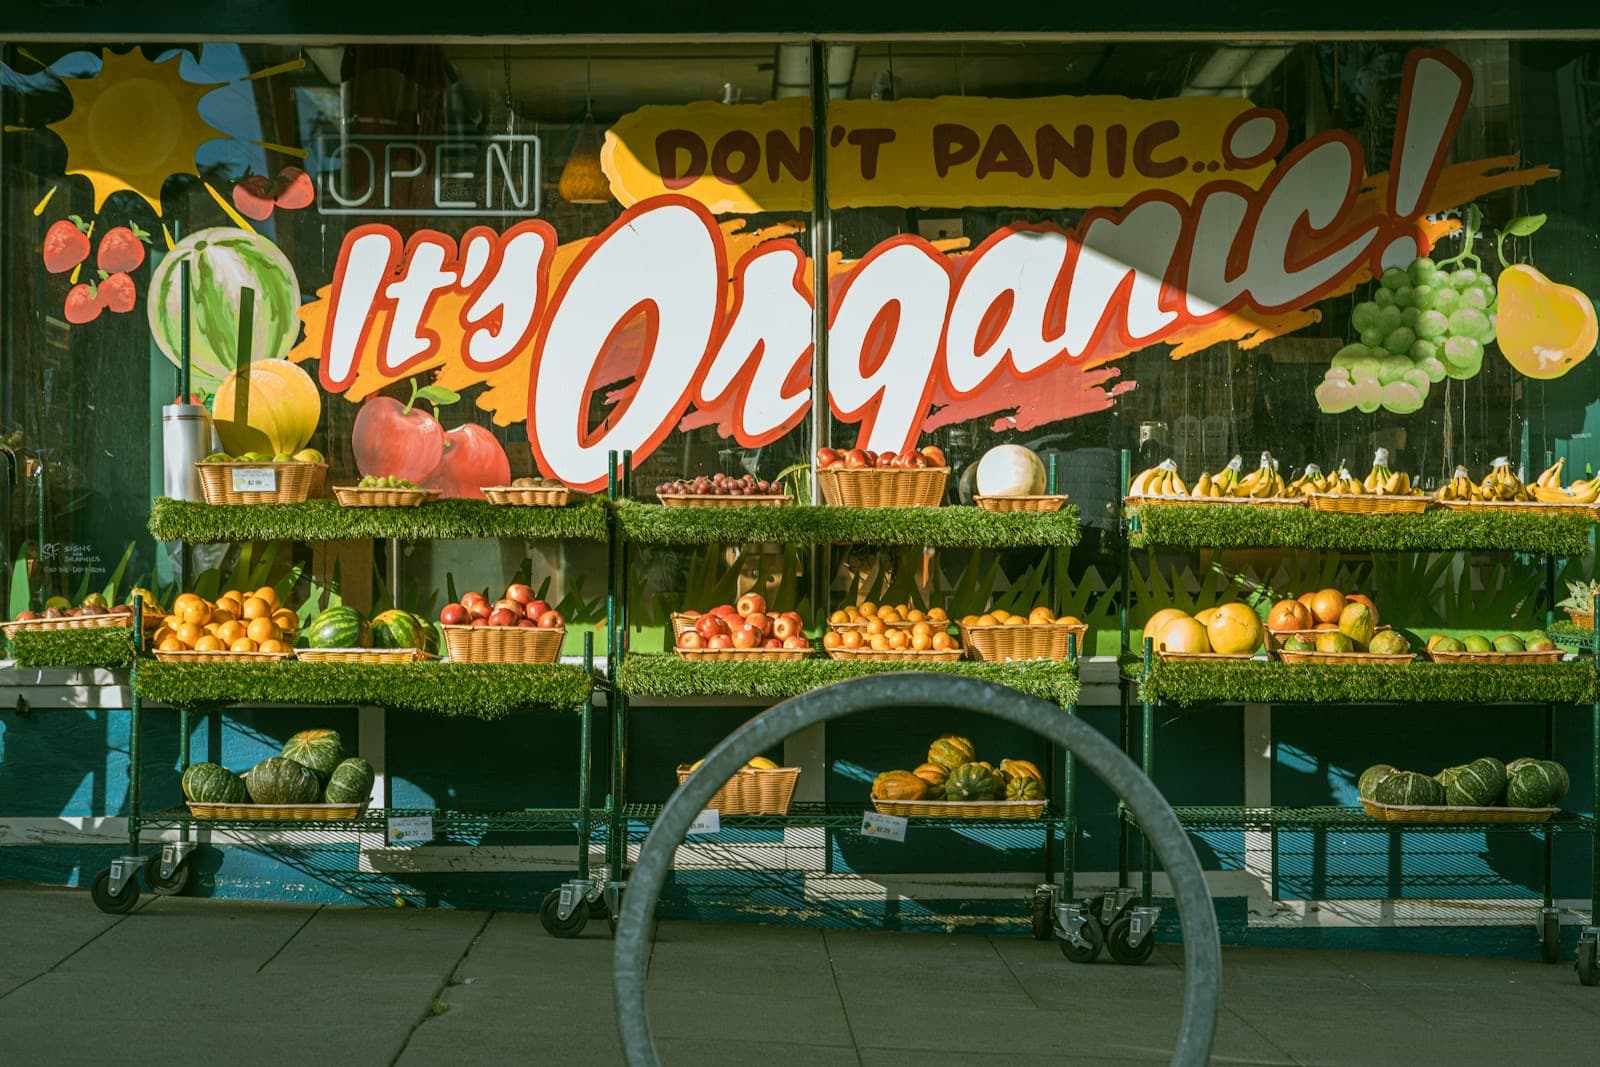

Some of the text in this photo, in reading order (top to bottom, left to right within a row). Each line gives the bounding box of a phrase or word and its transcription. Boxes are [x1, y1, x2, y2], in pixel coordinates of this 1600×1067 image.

[328, 143, 529, 208] OPEN
[655, 125, 896, 190] DON'T
[321, 48, 1473, 492] It's Organic!
